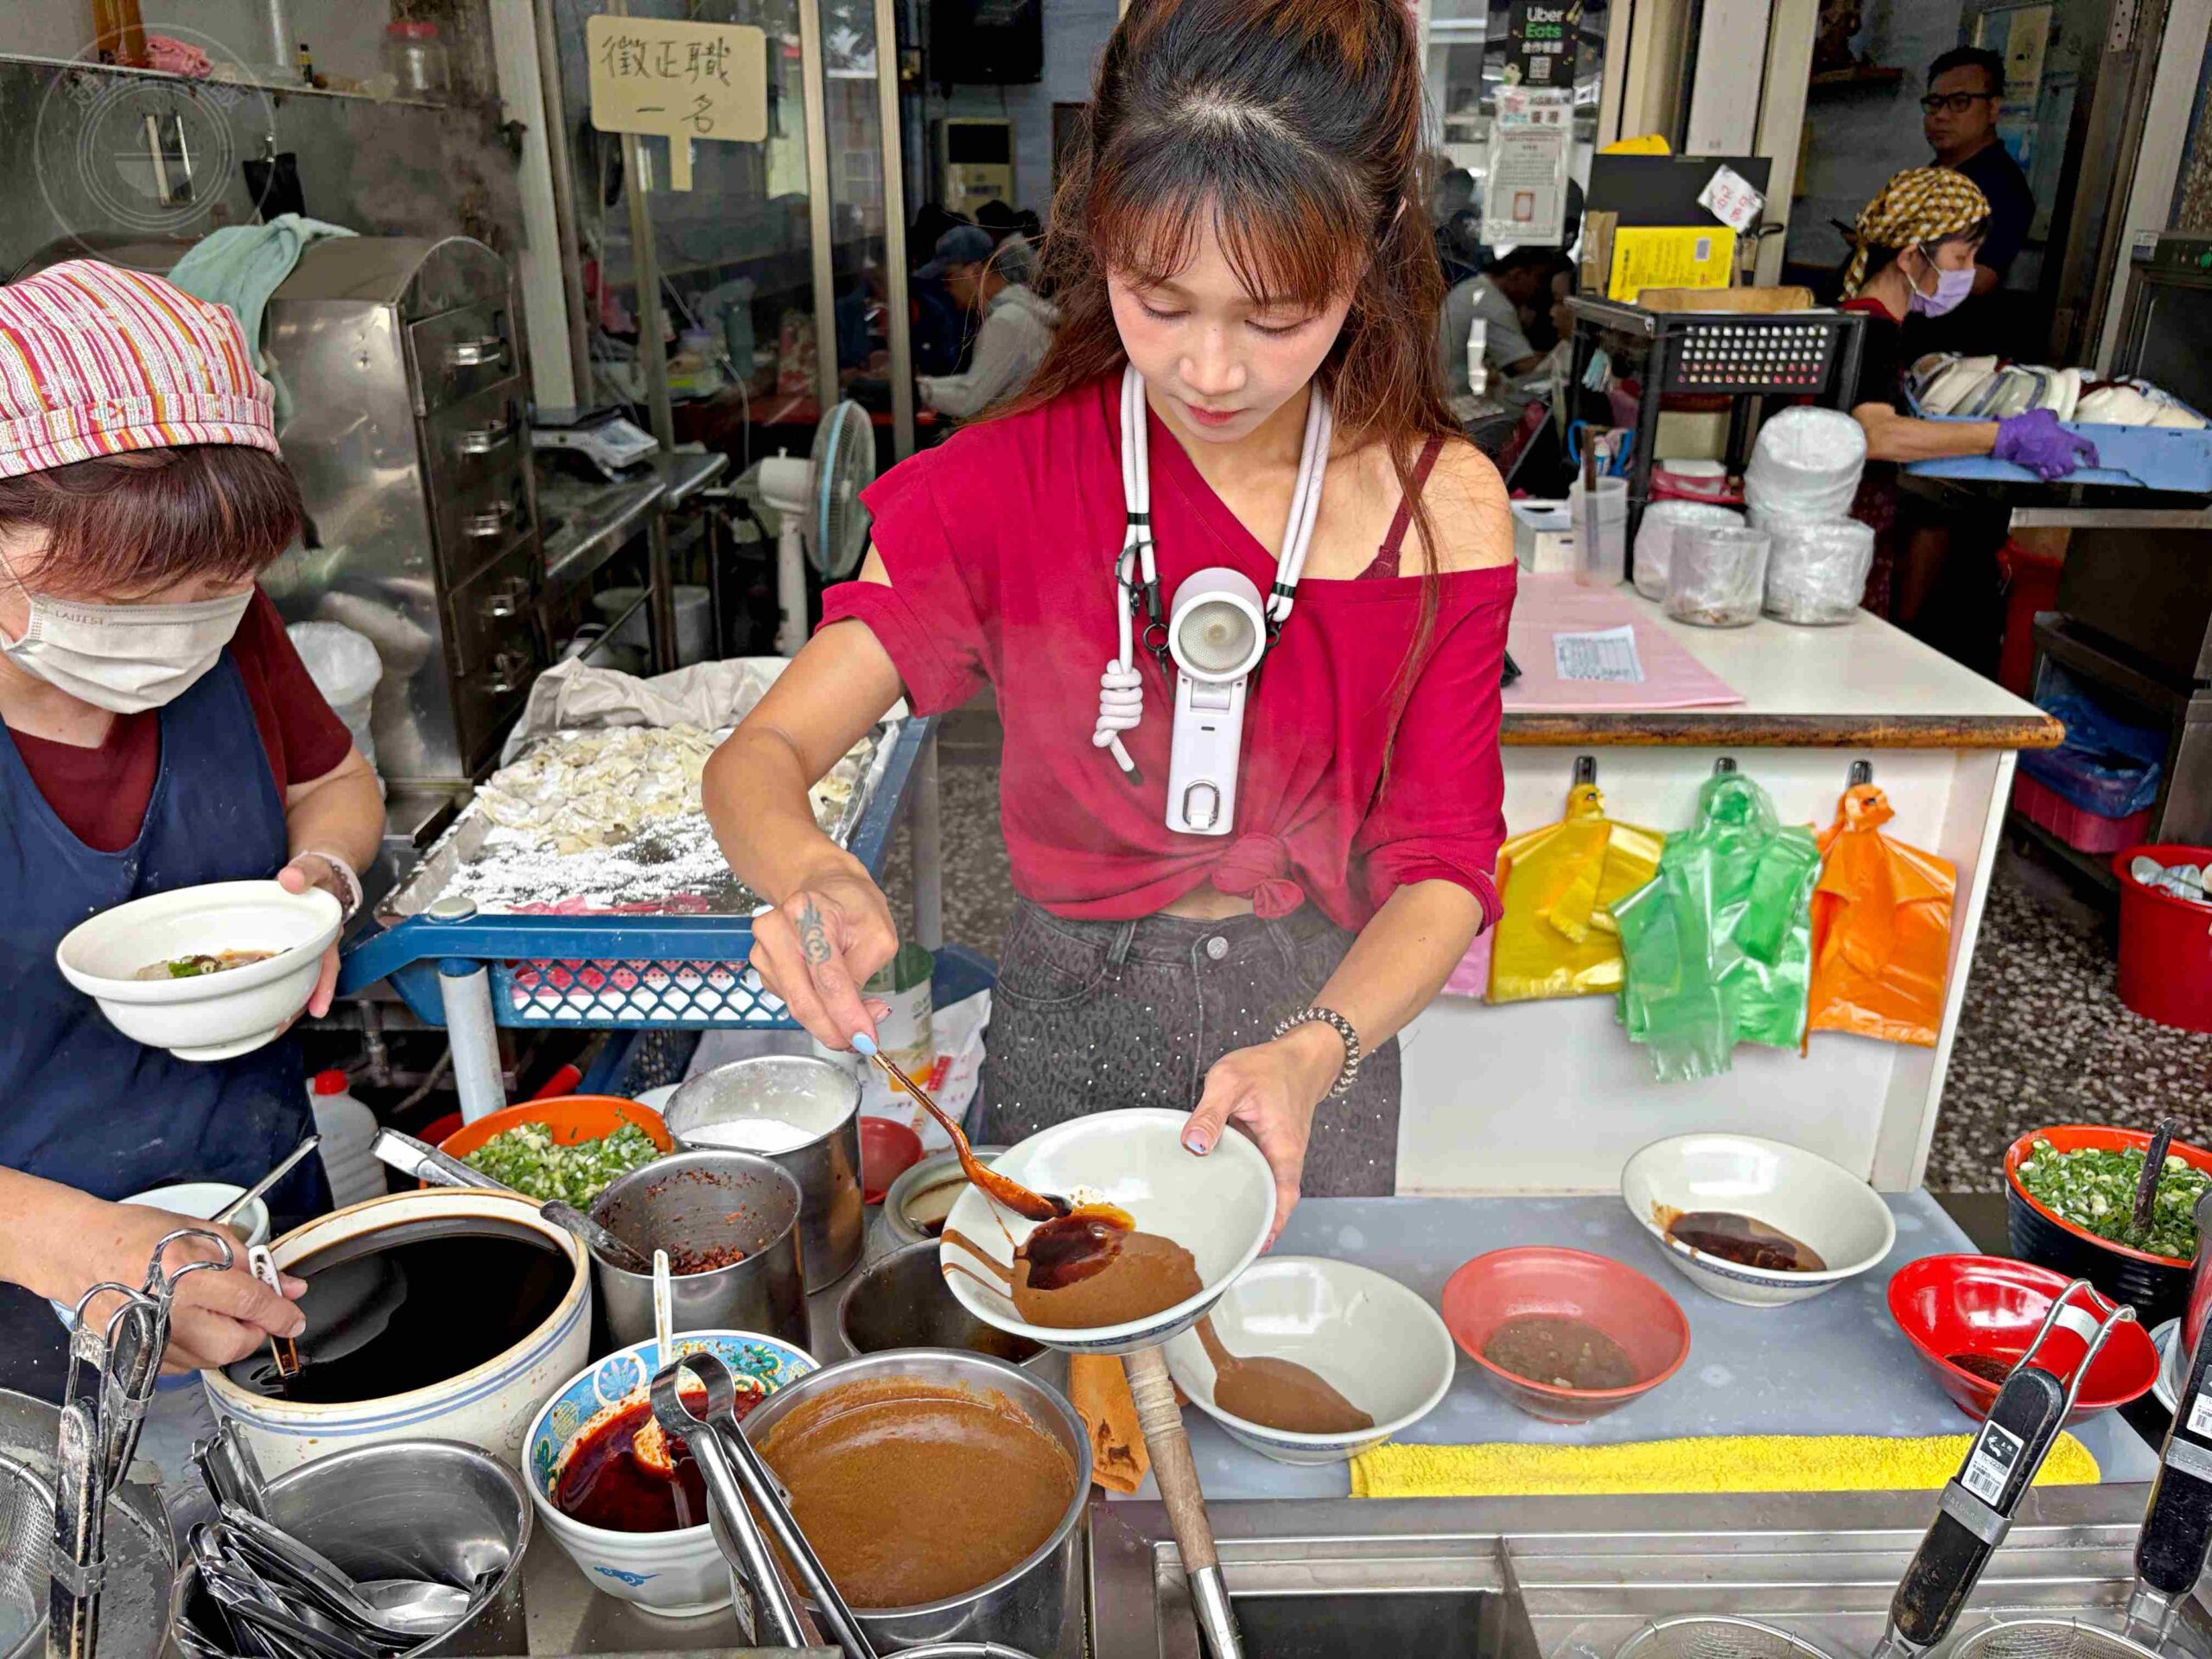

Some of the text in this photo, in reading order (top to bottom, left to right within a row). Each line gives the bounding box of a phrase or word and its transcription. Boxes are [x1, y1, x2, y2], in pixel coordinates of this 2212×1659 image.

[1527, 7, 1564, 22] Uber
[1525, 22, 1562, 38] Eats
[601, 35, 732, 86] 徵正職
